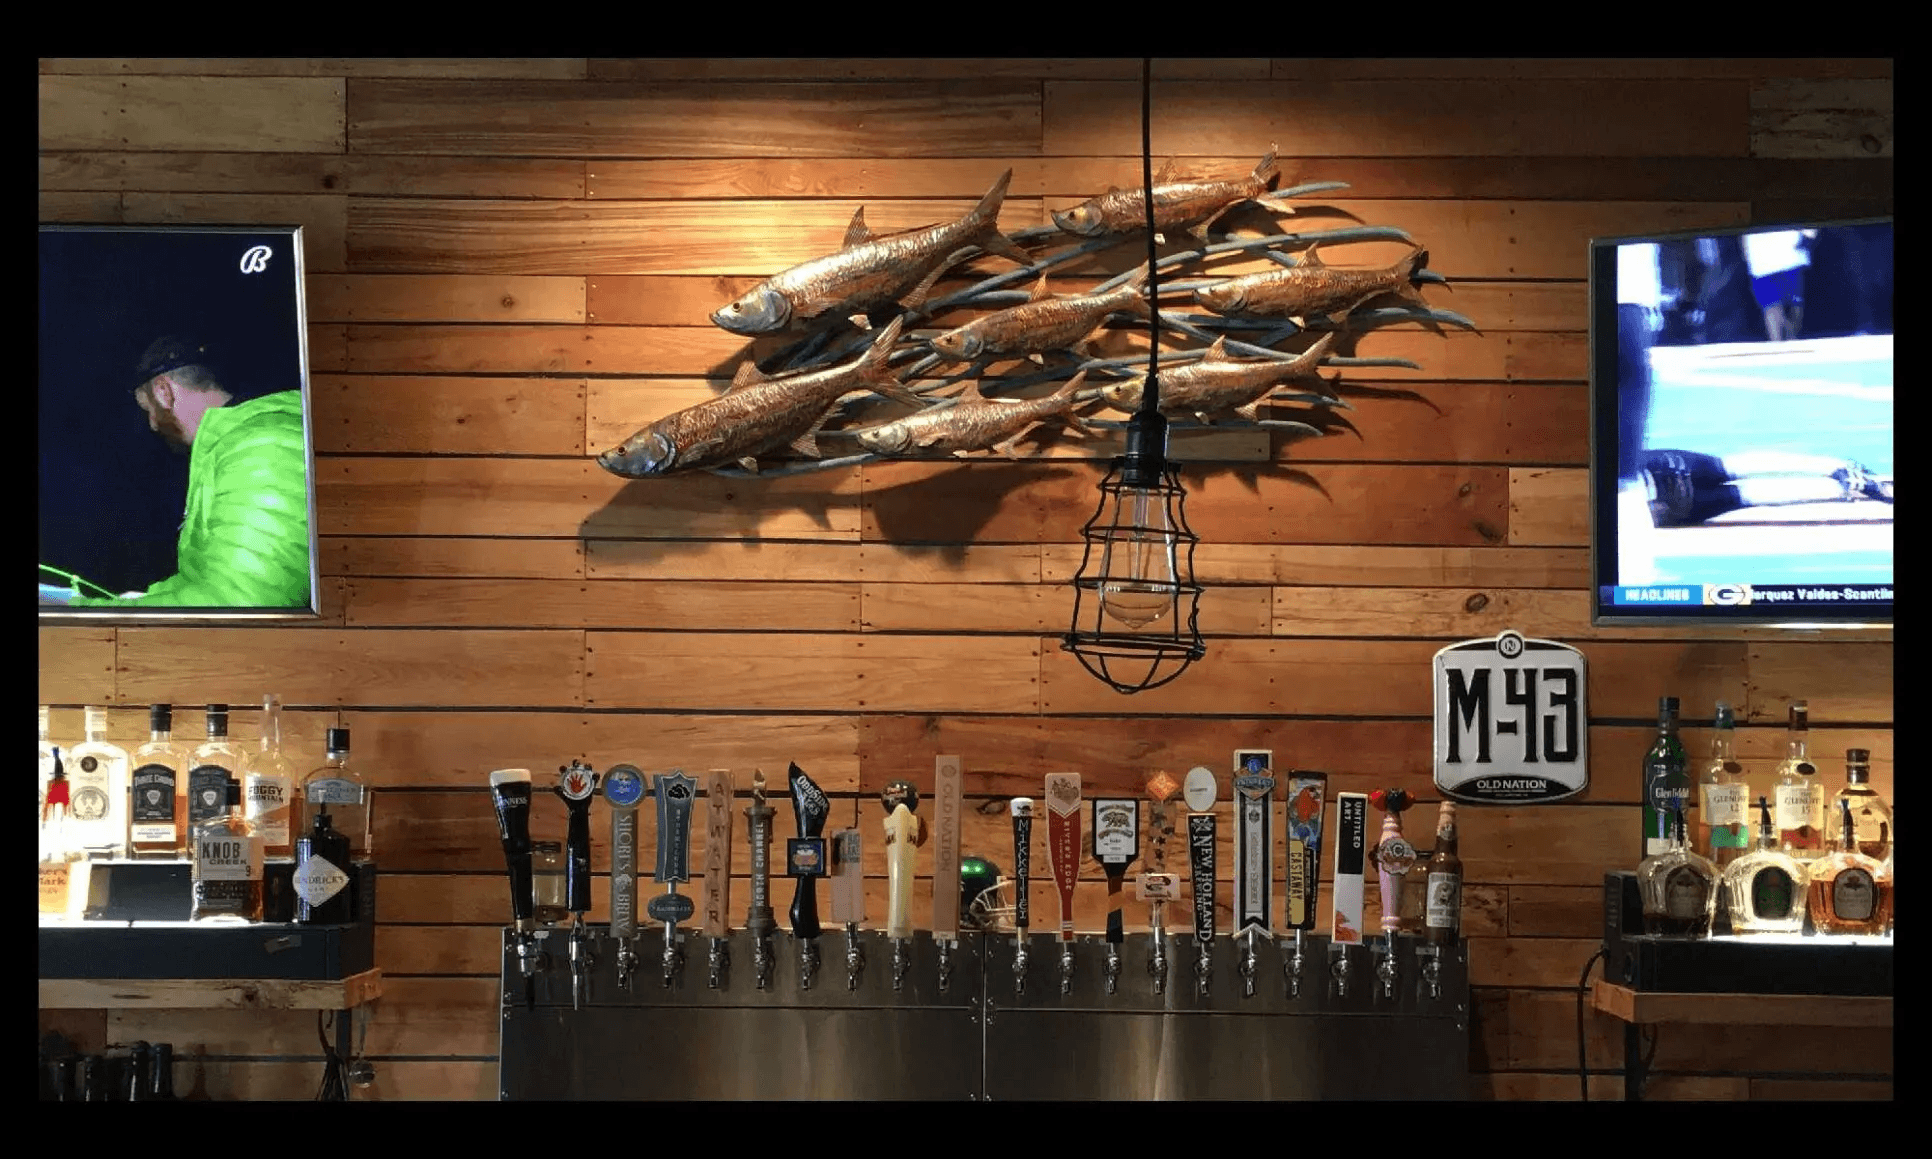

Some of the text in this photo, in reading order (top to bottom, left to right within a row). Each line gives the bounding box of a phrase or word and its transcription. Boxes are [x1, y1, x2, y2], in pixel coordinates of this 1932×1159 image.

[1625, 589, 1690, 601] HEADLINES
[1445, 668, 1578, 763] M-43
[248, 785, 284, 796] FOGGY
[1476, 779, 1547, 789] OLD NATION
[1353, 801, 1361, 848] UNTITLED
[202, 841, 241, 859] KNOB
[209, 858, 248, 866] CREEK
[708, 783, 725, 923] ATWATER
[755, 821, 765, 907] NORTH CHANNEL
[246, 865, 252, 877] 9
[1064, 863, 1072, 891] EDGE
[1290, 851, 1303, 900] CASTAWAY
[1193, 834, 1213, 941] NEW HOLLAND
